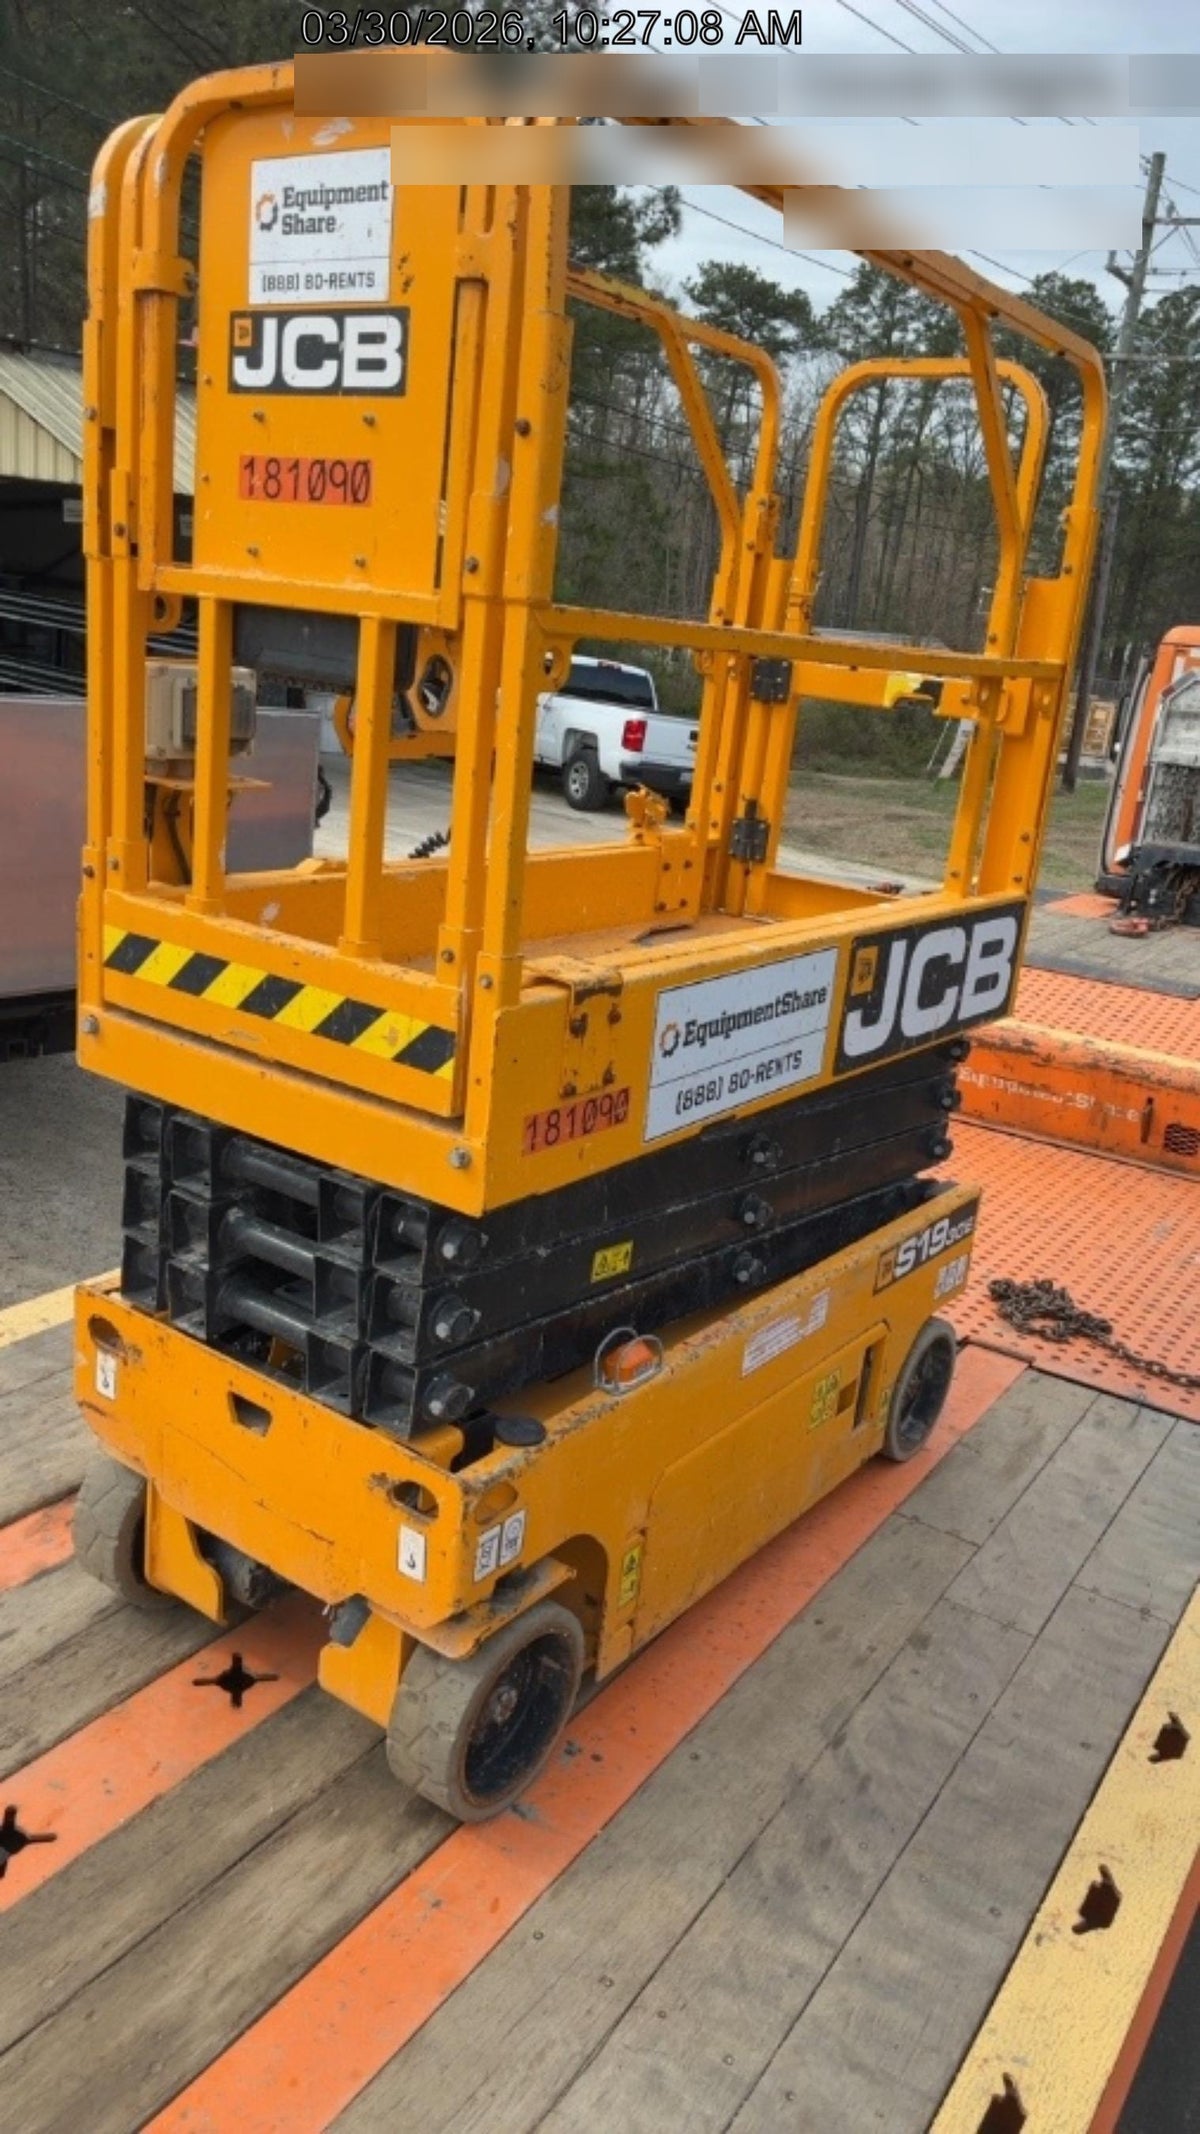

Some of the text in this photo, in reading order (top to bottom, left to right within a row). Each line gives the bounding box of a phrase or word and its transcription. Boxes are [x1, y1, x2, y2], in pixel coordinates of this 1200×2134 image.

[281, 214, 337, 236] Share
[282, 180, 389, 212] Equipment
[304, 271, 376, 291] 80-RENTS
[232, 314, 403, 389] JCB
[243, 456, 371, 504] 181090
[682, 985, 828, 1047] EquipmentShare
[843, 916, 1018, 1057] JCB
[675, 1049, 803, 1115] (888) 80-RENTS
[526, 1087, 630, 1152] 181090
